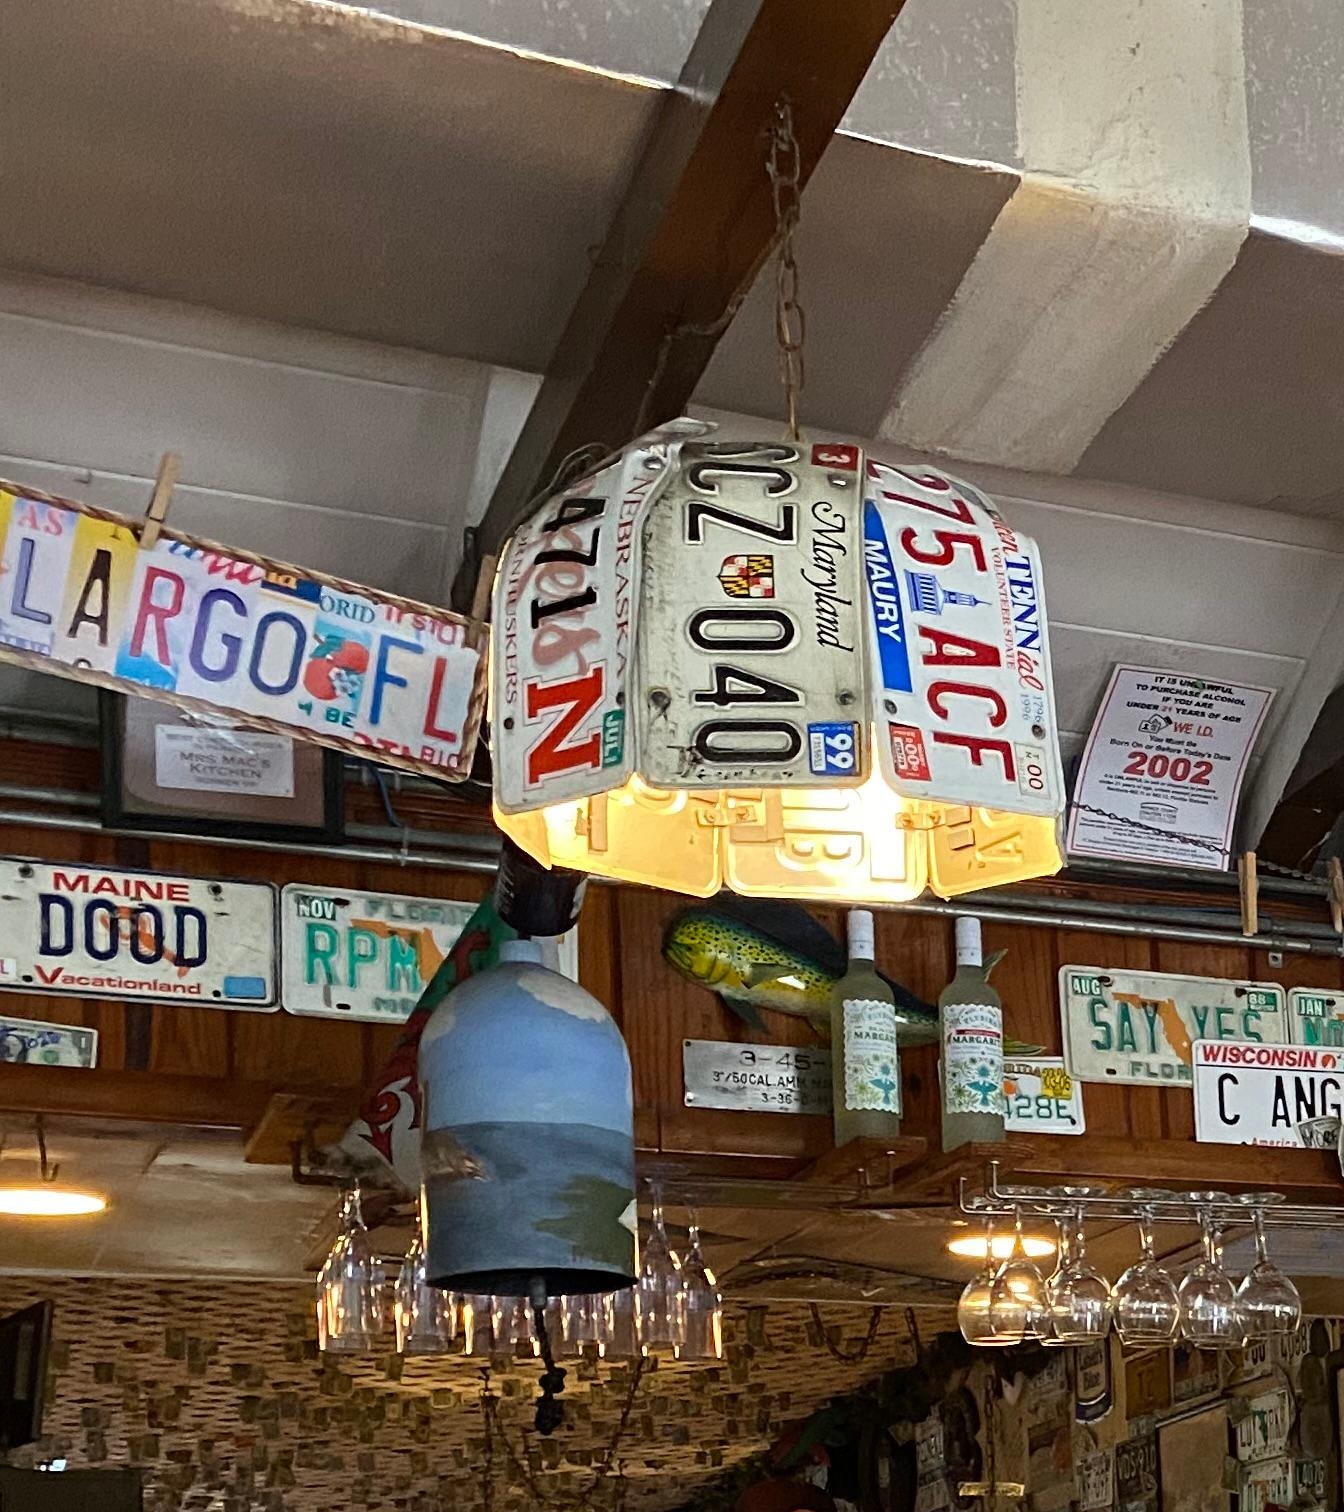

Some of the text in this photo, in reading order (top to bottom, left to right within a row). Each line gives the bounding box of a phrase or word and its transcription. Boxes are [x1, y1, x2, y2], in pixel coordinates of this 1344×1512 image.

[614, 475, 649, 677] NEBRASKA
[800, 502, 854, 653] Maryland
[863, 540, 901, 643] MAURY
[11, 537, 457, 743] LARGO FL
[686, 607, 802, 768] 040
[917, 625, 1015, 783] ACF
[1126, 701, 1205, 718] UNDER YEARS
[1150, 685, 1200, 698] PURCHASE
[1173, 722, 1194, 734] WE
[1123, 751, 1214, 785] 2002
[52, 872, 190, 902] MAINE
[38, 893, 208, 968] DOOD
[34, 964, 201, 996] Vacationland
[1073, 977, 1100, 995] AUG
[1089, 999, 1161, 1054] SAY
[1192, 1006, 1264, 1044] YES
[1202, 1046, 1318, 1068] WISCONSIN
[1218, 1073, 1239, 1127] C
